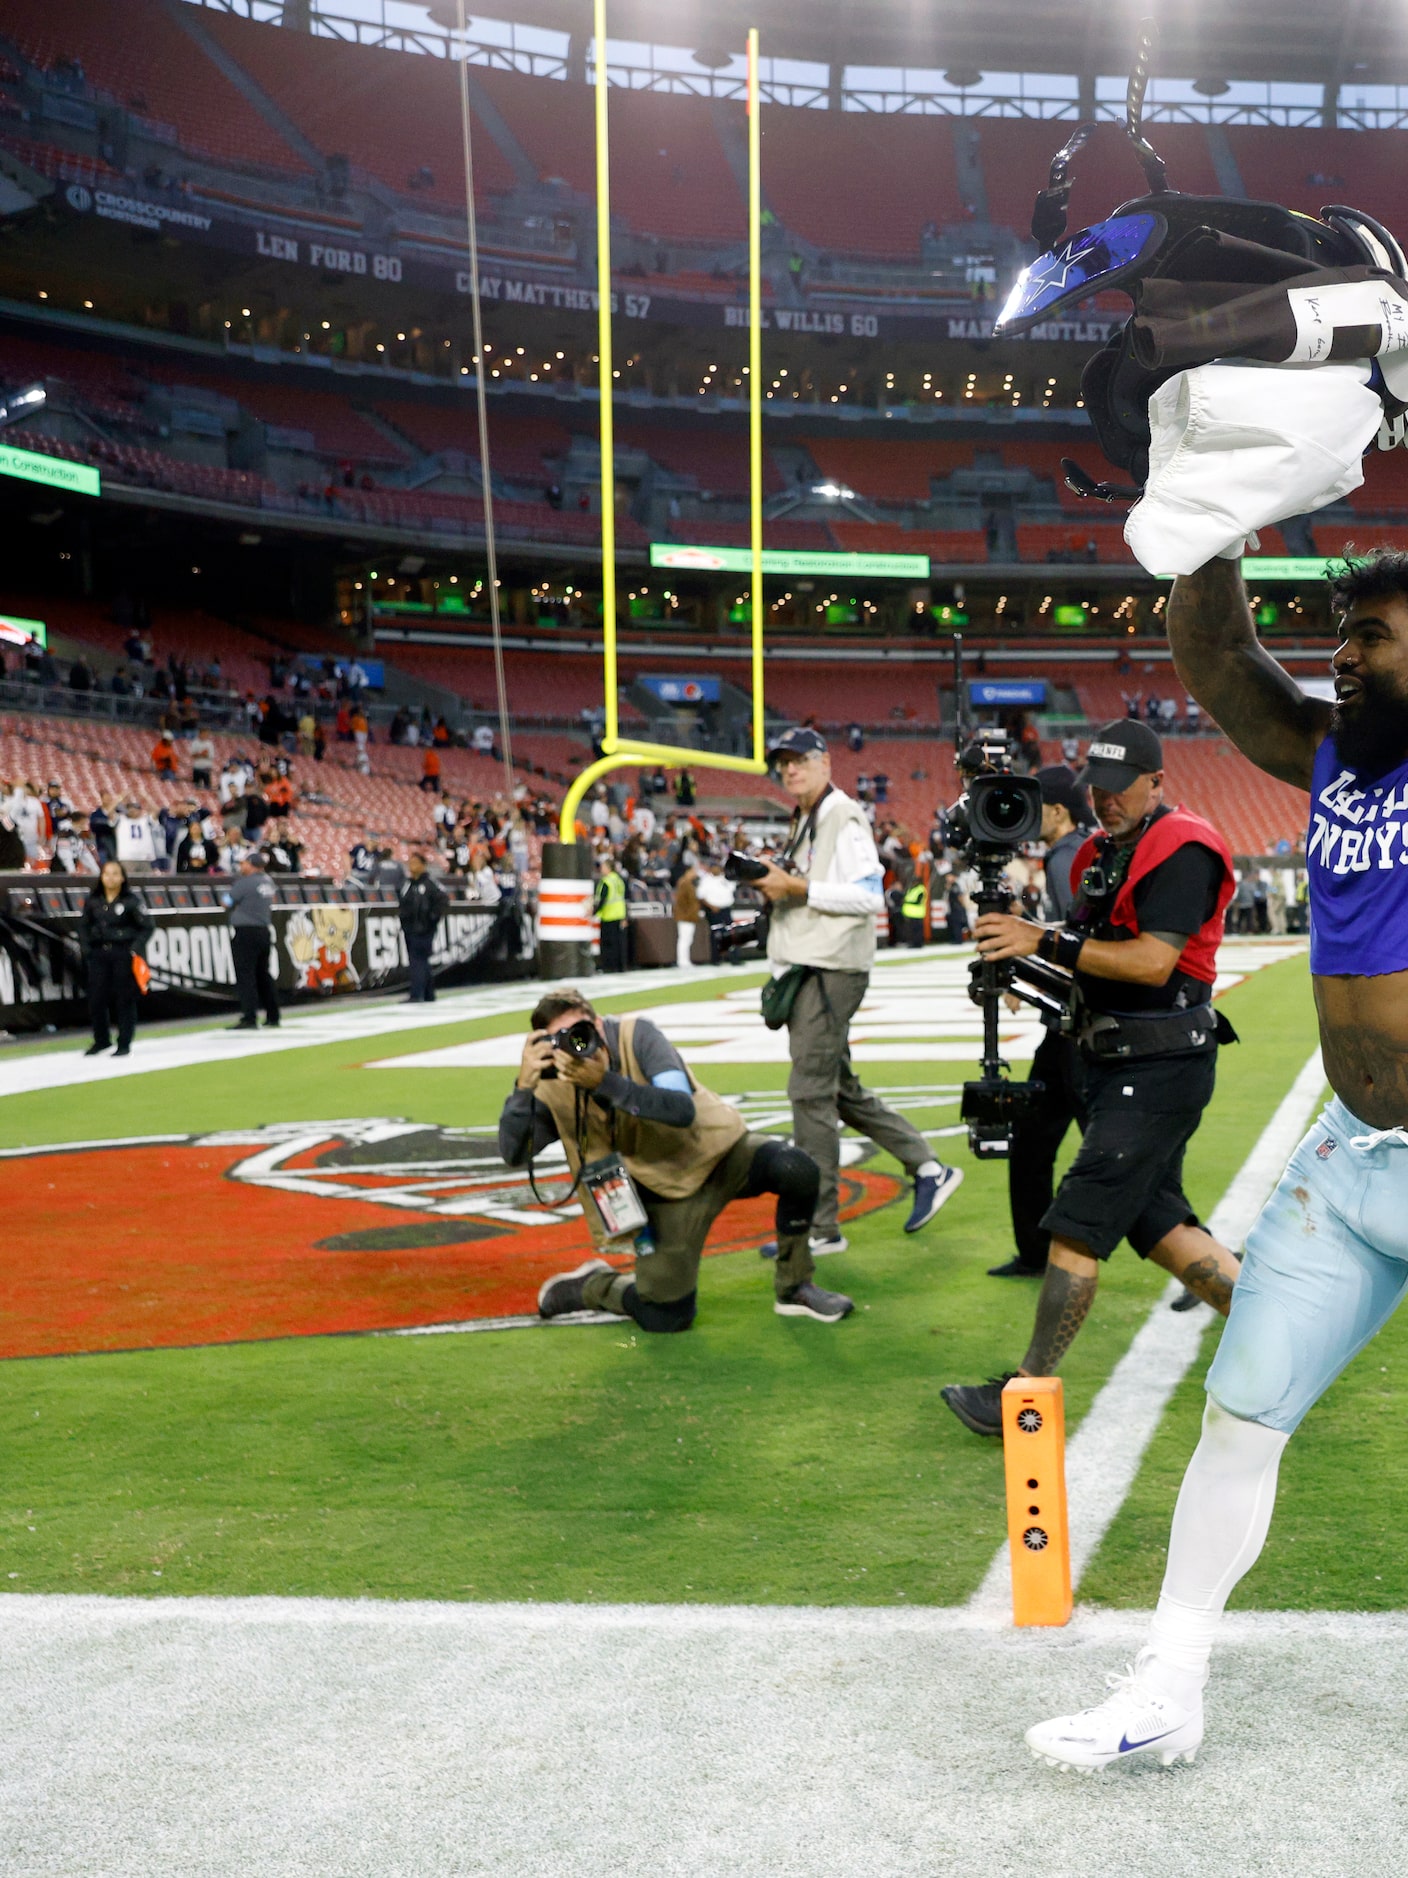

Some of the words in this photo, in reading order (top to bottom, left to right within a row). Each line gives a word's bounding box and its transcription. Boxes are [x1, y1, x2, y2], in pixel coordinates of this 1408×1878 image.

[256, 232, 299, 262] LEN
[310, 243, 367, 274] FORD
[373, 254, 403, 282] 80
[624, 294, 651, 319] 57
[774, 309, 844, 334] WILLIS
[850, 314, 878, 337] 60
